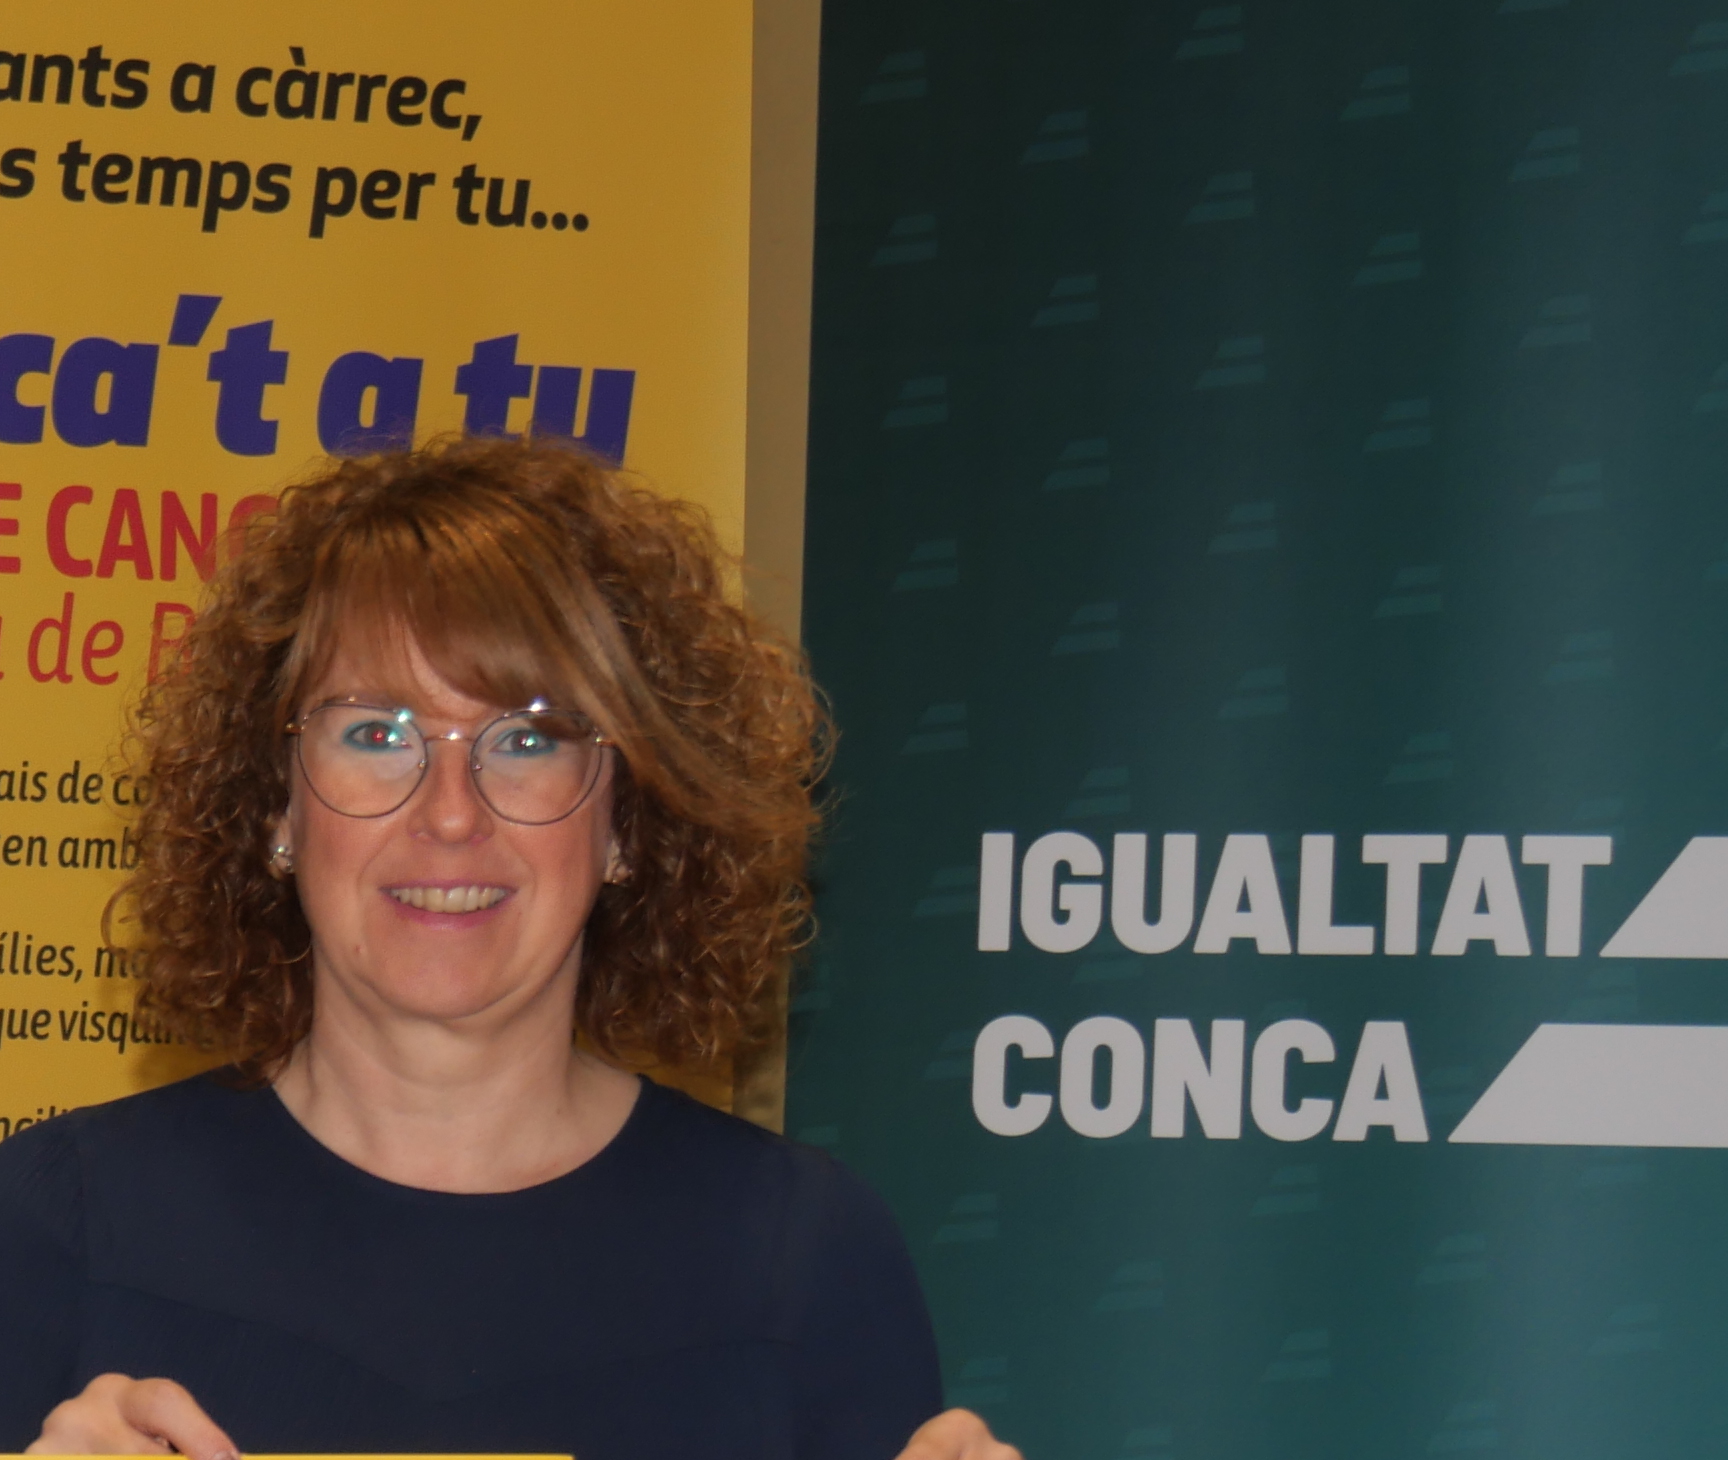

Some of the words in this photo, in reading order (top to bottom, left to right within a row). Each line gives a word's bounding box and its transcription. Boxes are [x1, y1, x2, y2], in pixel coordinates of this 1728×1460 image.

[170, 63, 216, 113] a
[236, 47, 482, 141] càrrec,
[58, 140, 292, 233] temps
[309, 167, 436, 238] per
[453, 164, 589, 231] tu...
[316, 351, 424, 458] a
[454, 333, 636, 470] tu
[27, 591, 122, 685] de
[57, 759, 110, 804] de
[978, 832, 1614, 957] IGUALTAT
[973, 1015, 1429, 1142] CONCA
